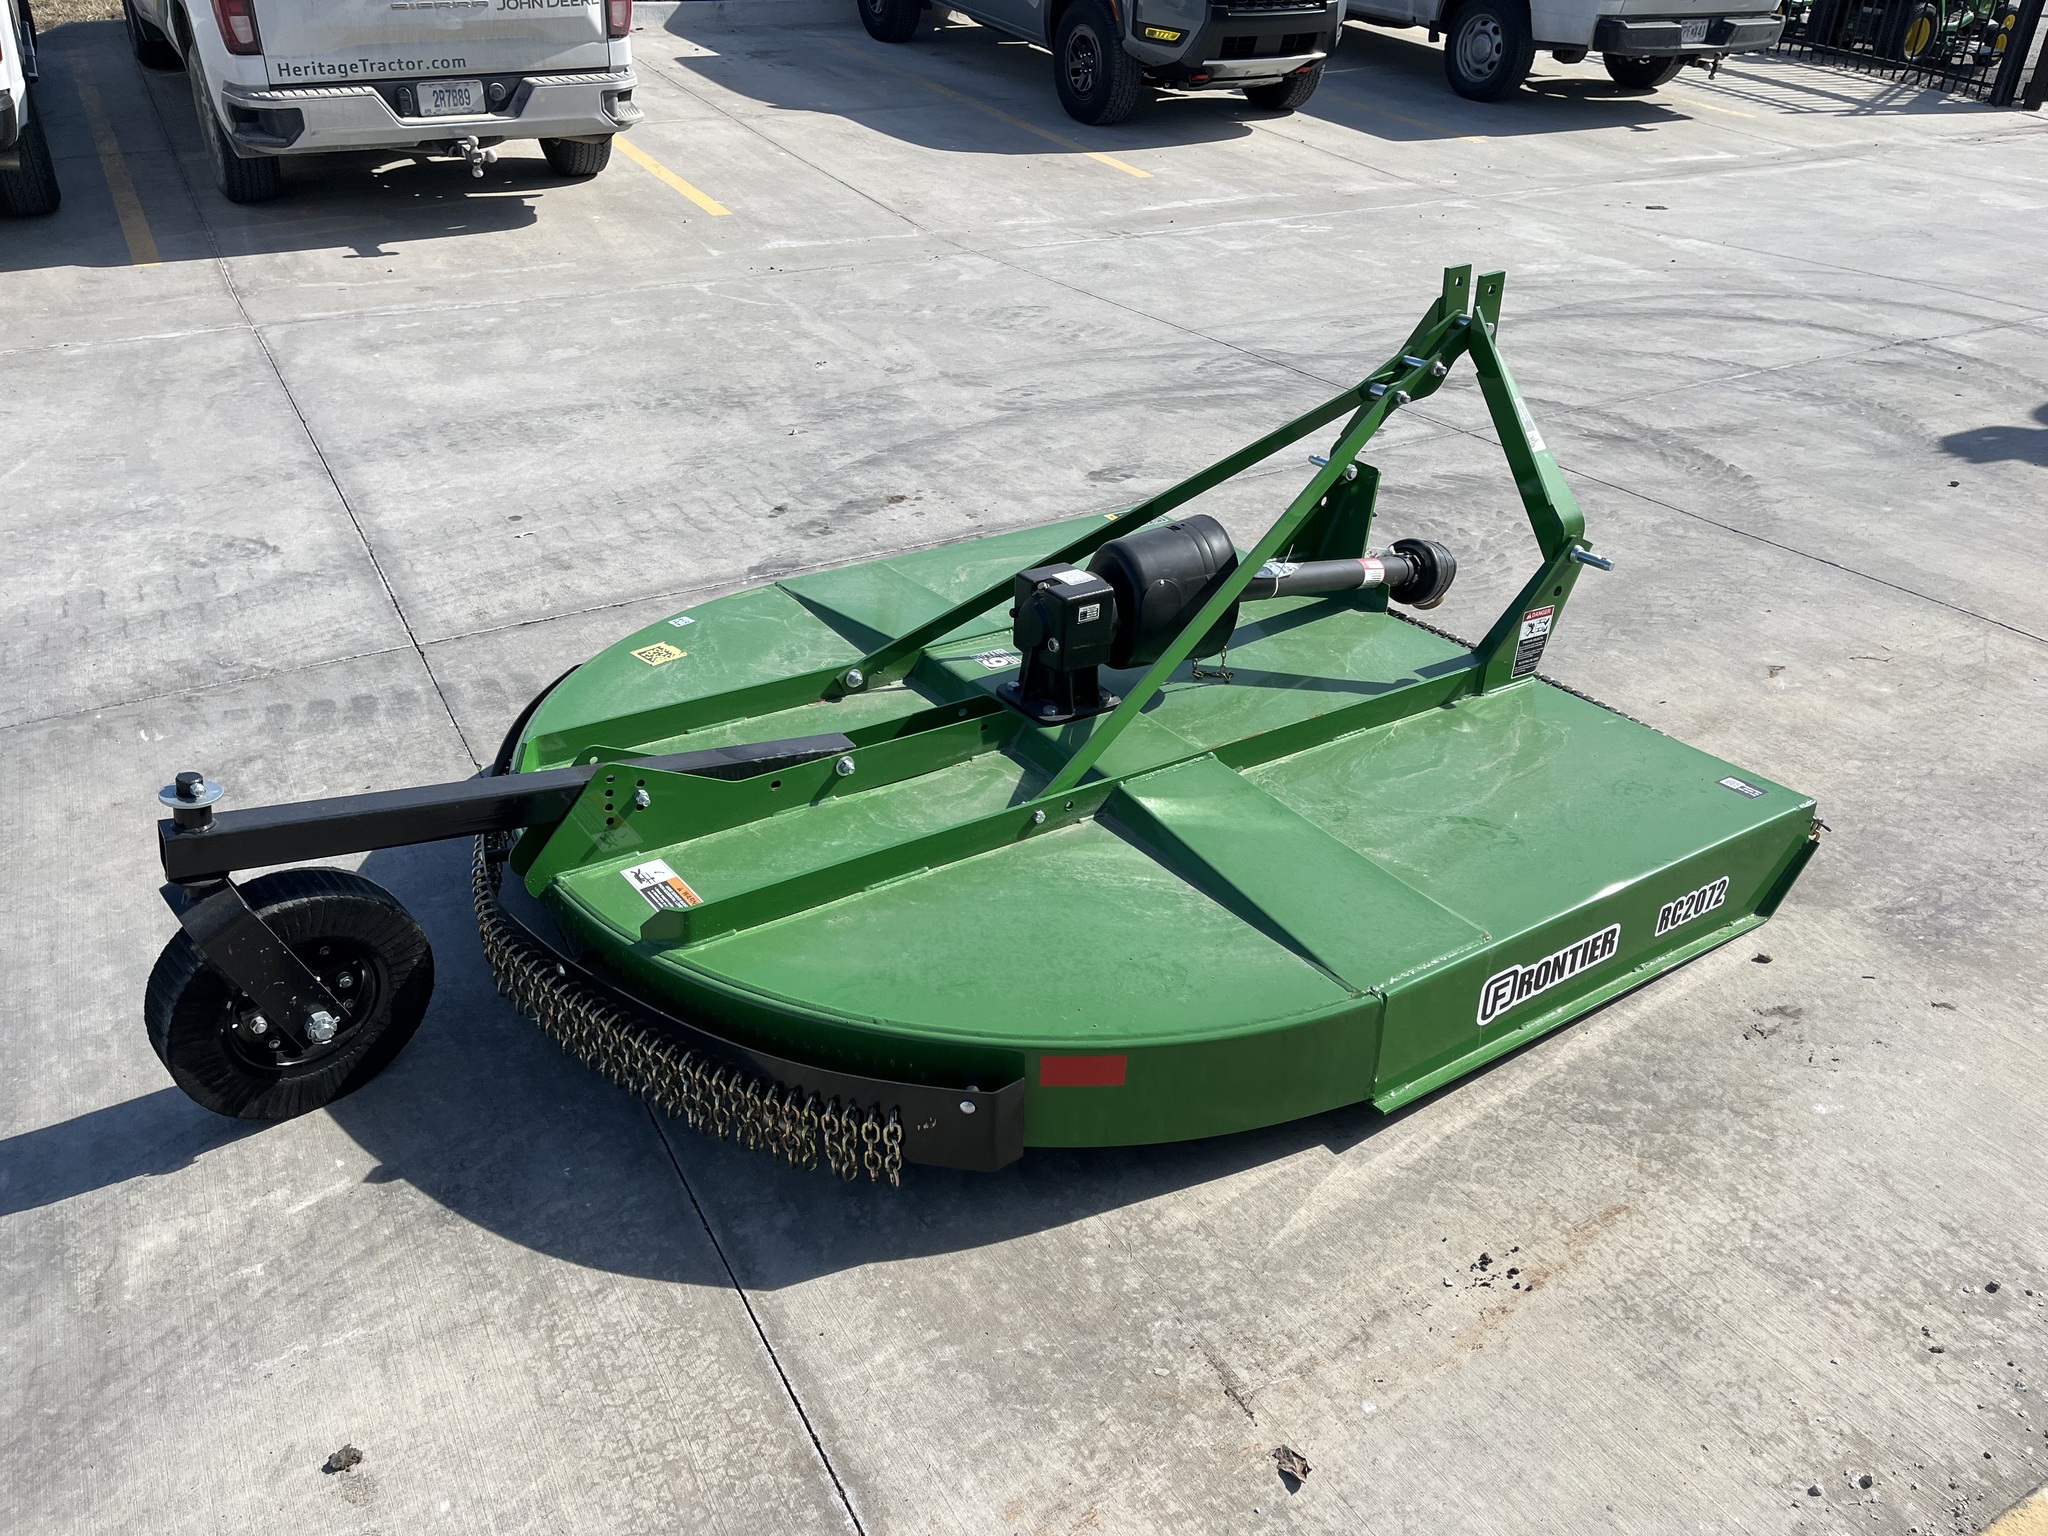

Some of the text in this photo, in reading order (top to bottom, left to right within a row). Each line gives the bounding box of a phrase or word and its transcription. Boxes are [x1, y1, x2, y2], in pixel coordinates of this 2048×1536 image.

[497, 0, 543, 11] JOHN
[277, 57, 467, 79] HeritageTractor.com
[1531, 608, 1552, 618] DANGER
[1656, 878, 1728, 934] RC2072
[1479, 925, 1619, 1022] FRONTIER
